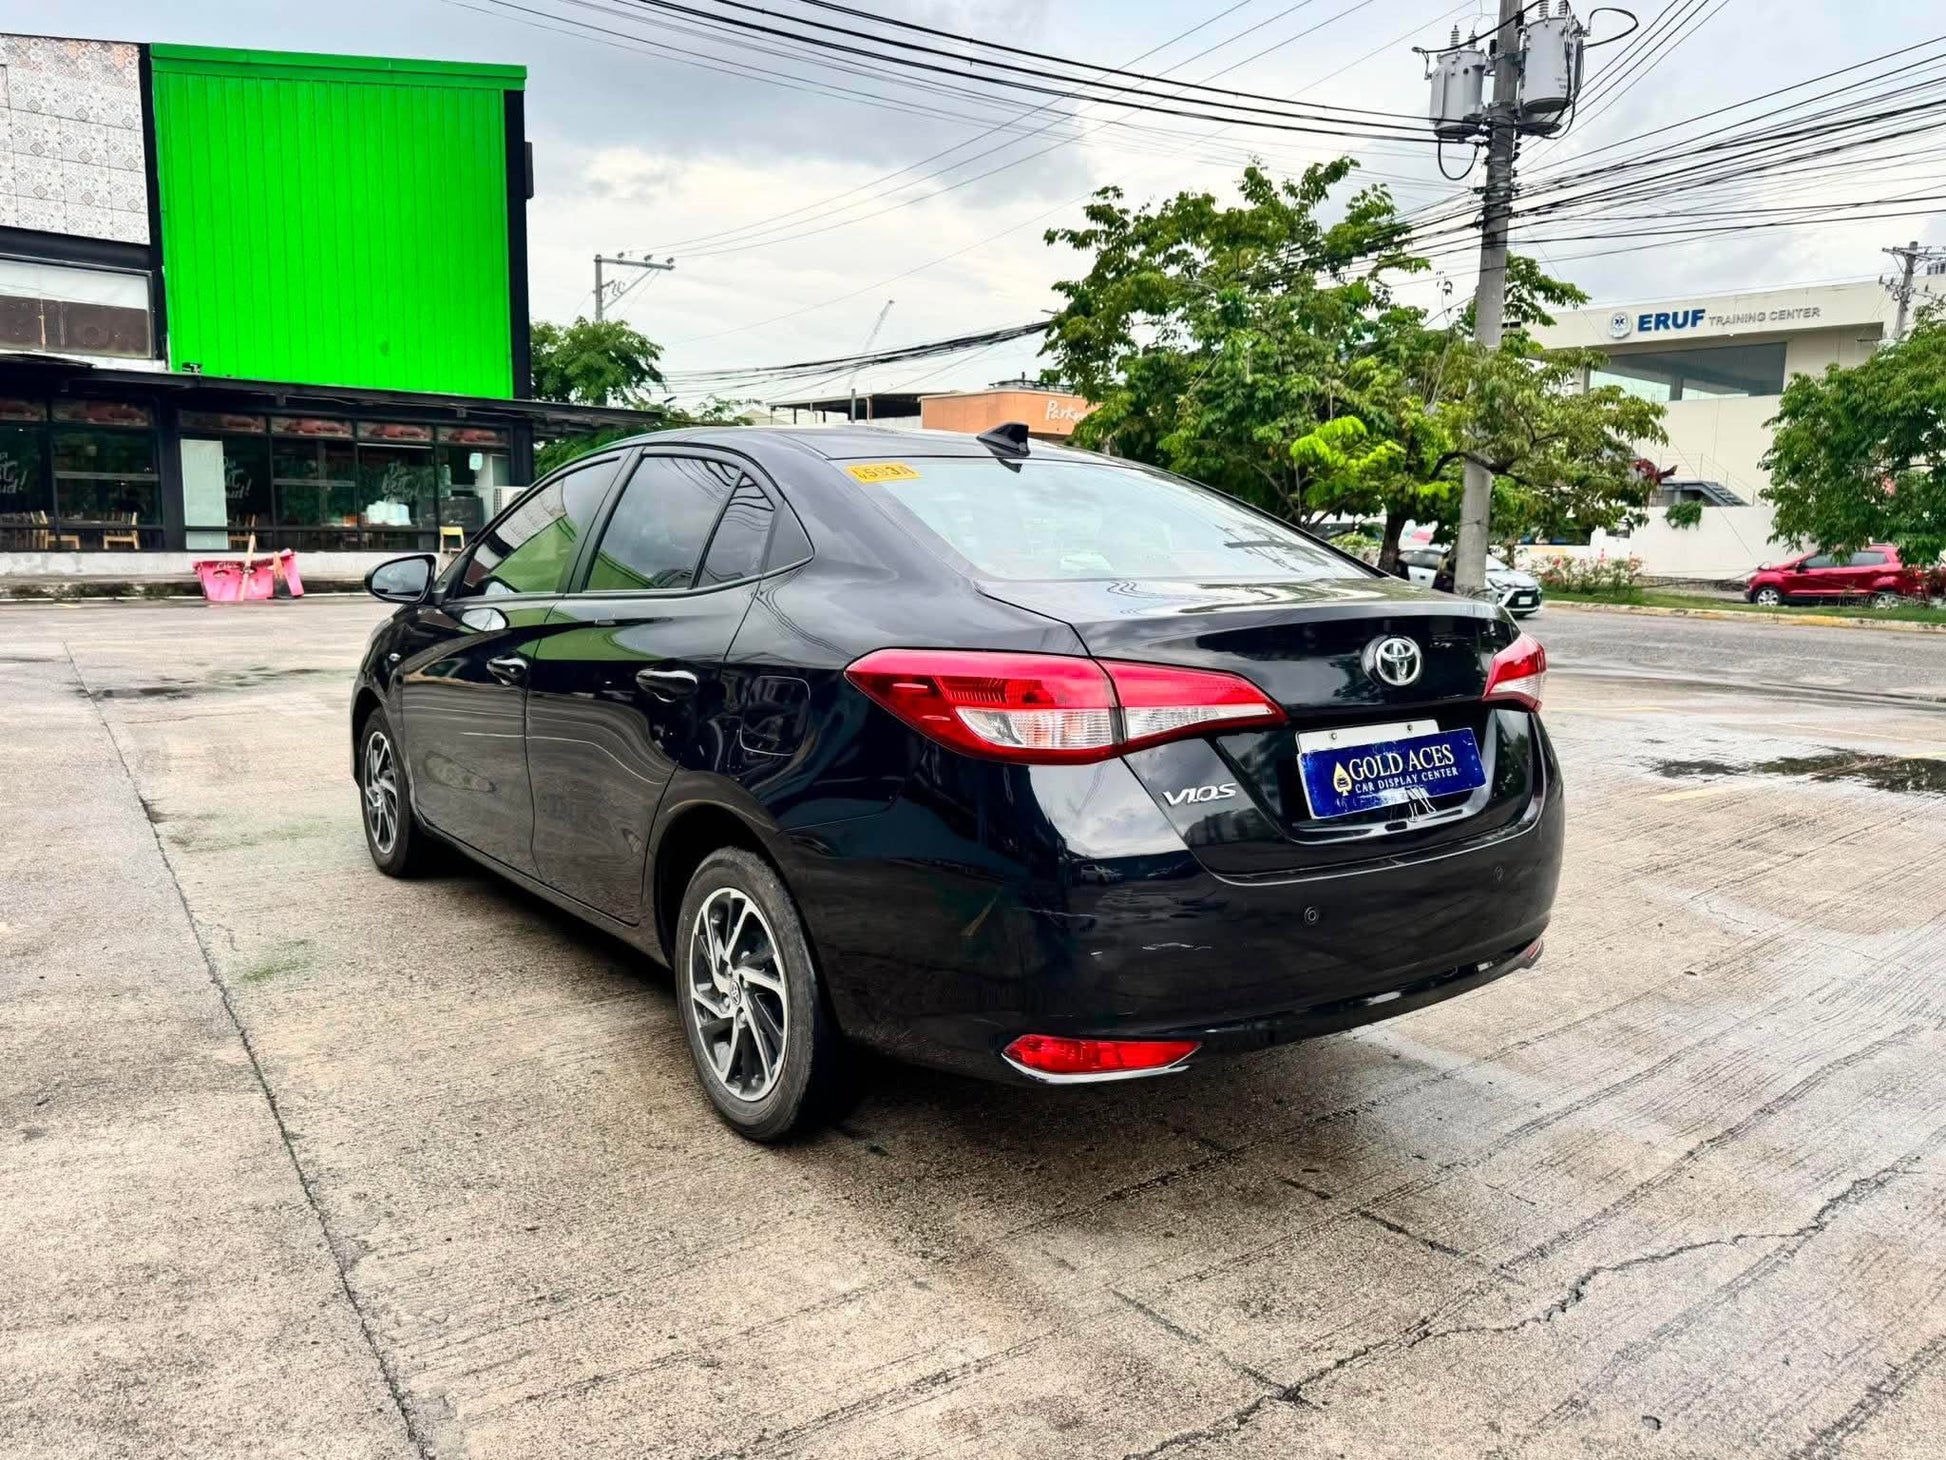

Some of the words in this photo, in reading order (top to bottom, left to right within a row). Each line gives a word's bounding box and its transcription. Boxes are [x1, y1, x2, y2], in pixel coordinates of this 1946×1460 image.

[1637, 308, 1706, 332] ERUF
[1709, 311, 1766, 326] TRAINING
[1769, 307, 1821, 321] CENTER
[1348, 752, 1404, 782] GOLD
[1408, 743, 1455, 772] ACES
[1354, 780, 1375, 794] CAR
[1377, 773, 1419, 790] DISPLAY
[1421, 766, 1459, 781] CENTER
[1161, 782, 1237, 806] VIOS
